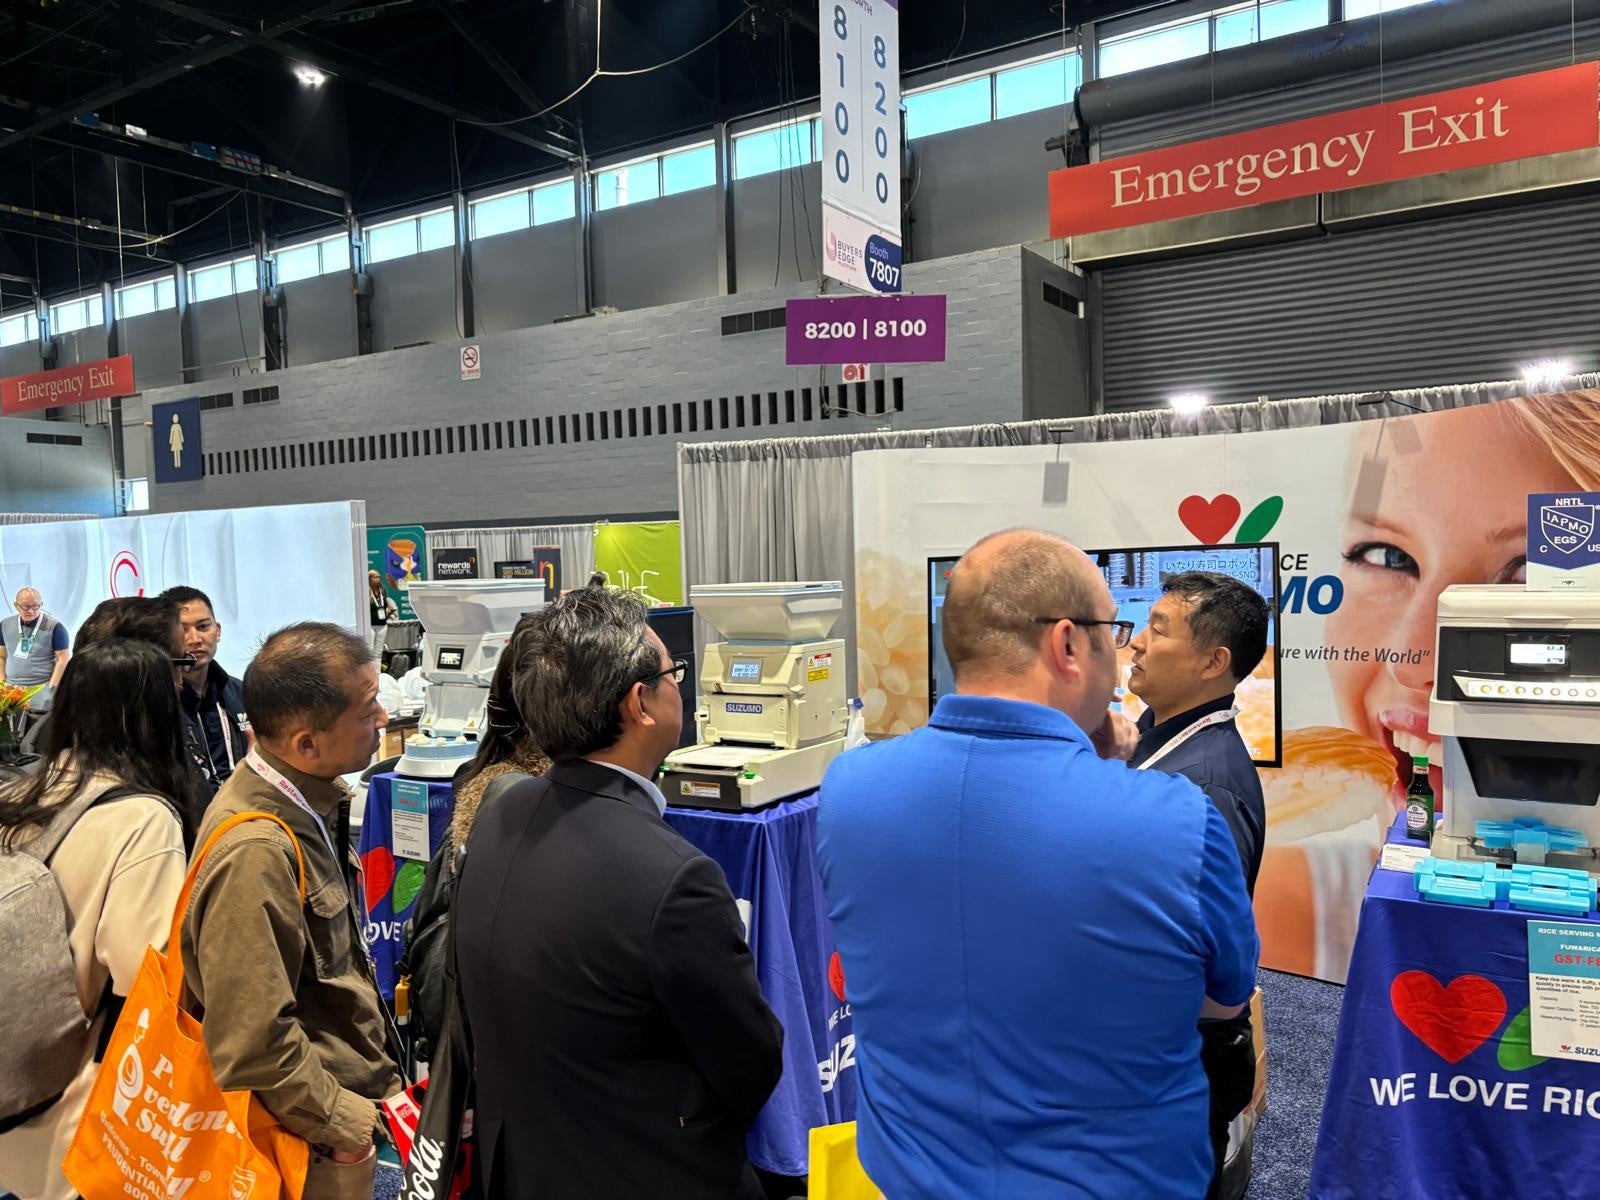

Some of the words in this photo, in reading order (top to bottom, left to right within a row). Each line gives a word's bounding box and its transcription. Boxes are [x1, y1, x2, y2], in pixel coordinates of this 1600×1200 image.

[833, 4, 849, 184] 8100
[873, 35, 888, 204] 8200
[1110, 129, 1376, 208] Emergency
[1398, 96, 1510, 155] Exit
[837, 240, 863, 260] BUYERS
[837, 252, 855, 266] EDGE
[869, 241, 889, 260] Booth
[869, 258, 899, 287] 7807
[805, 322, 856, 339] 8200
[874, 319, 927, 337] 8100
[17, 375, 84, 402] Emergency
[88, 365, 115, 389] Exit
[1555, 498, 1585, 506] NRTL
[1546, 512, 1589, 535] IAPMO
[1539, 545, 1549, 553] C
[1554, 536, 1578, 544] EGS
[1165, 558, 1256, 570] いなり寿司ロボット
[1280, 554, 1309, 571] CE
[1305, 646, 1339, 661] with
[1343, 647, 1370, 662] the
[726, 703, 762, 713] SUZUMO
[1558, 929, 1594, 937] SERVING
[828, 1012, 839, 1031] WE
[1369, 1073, 1416, 1106] WE
[1428, 1073, 1529, 1110] LOVE
